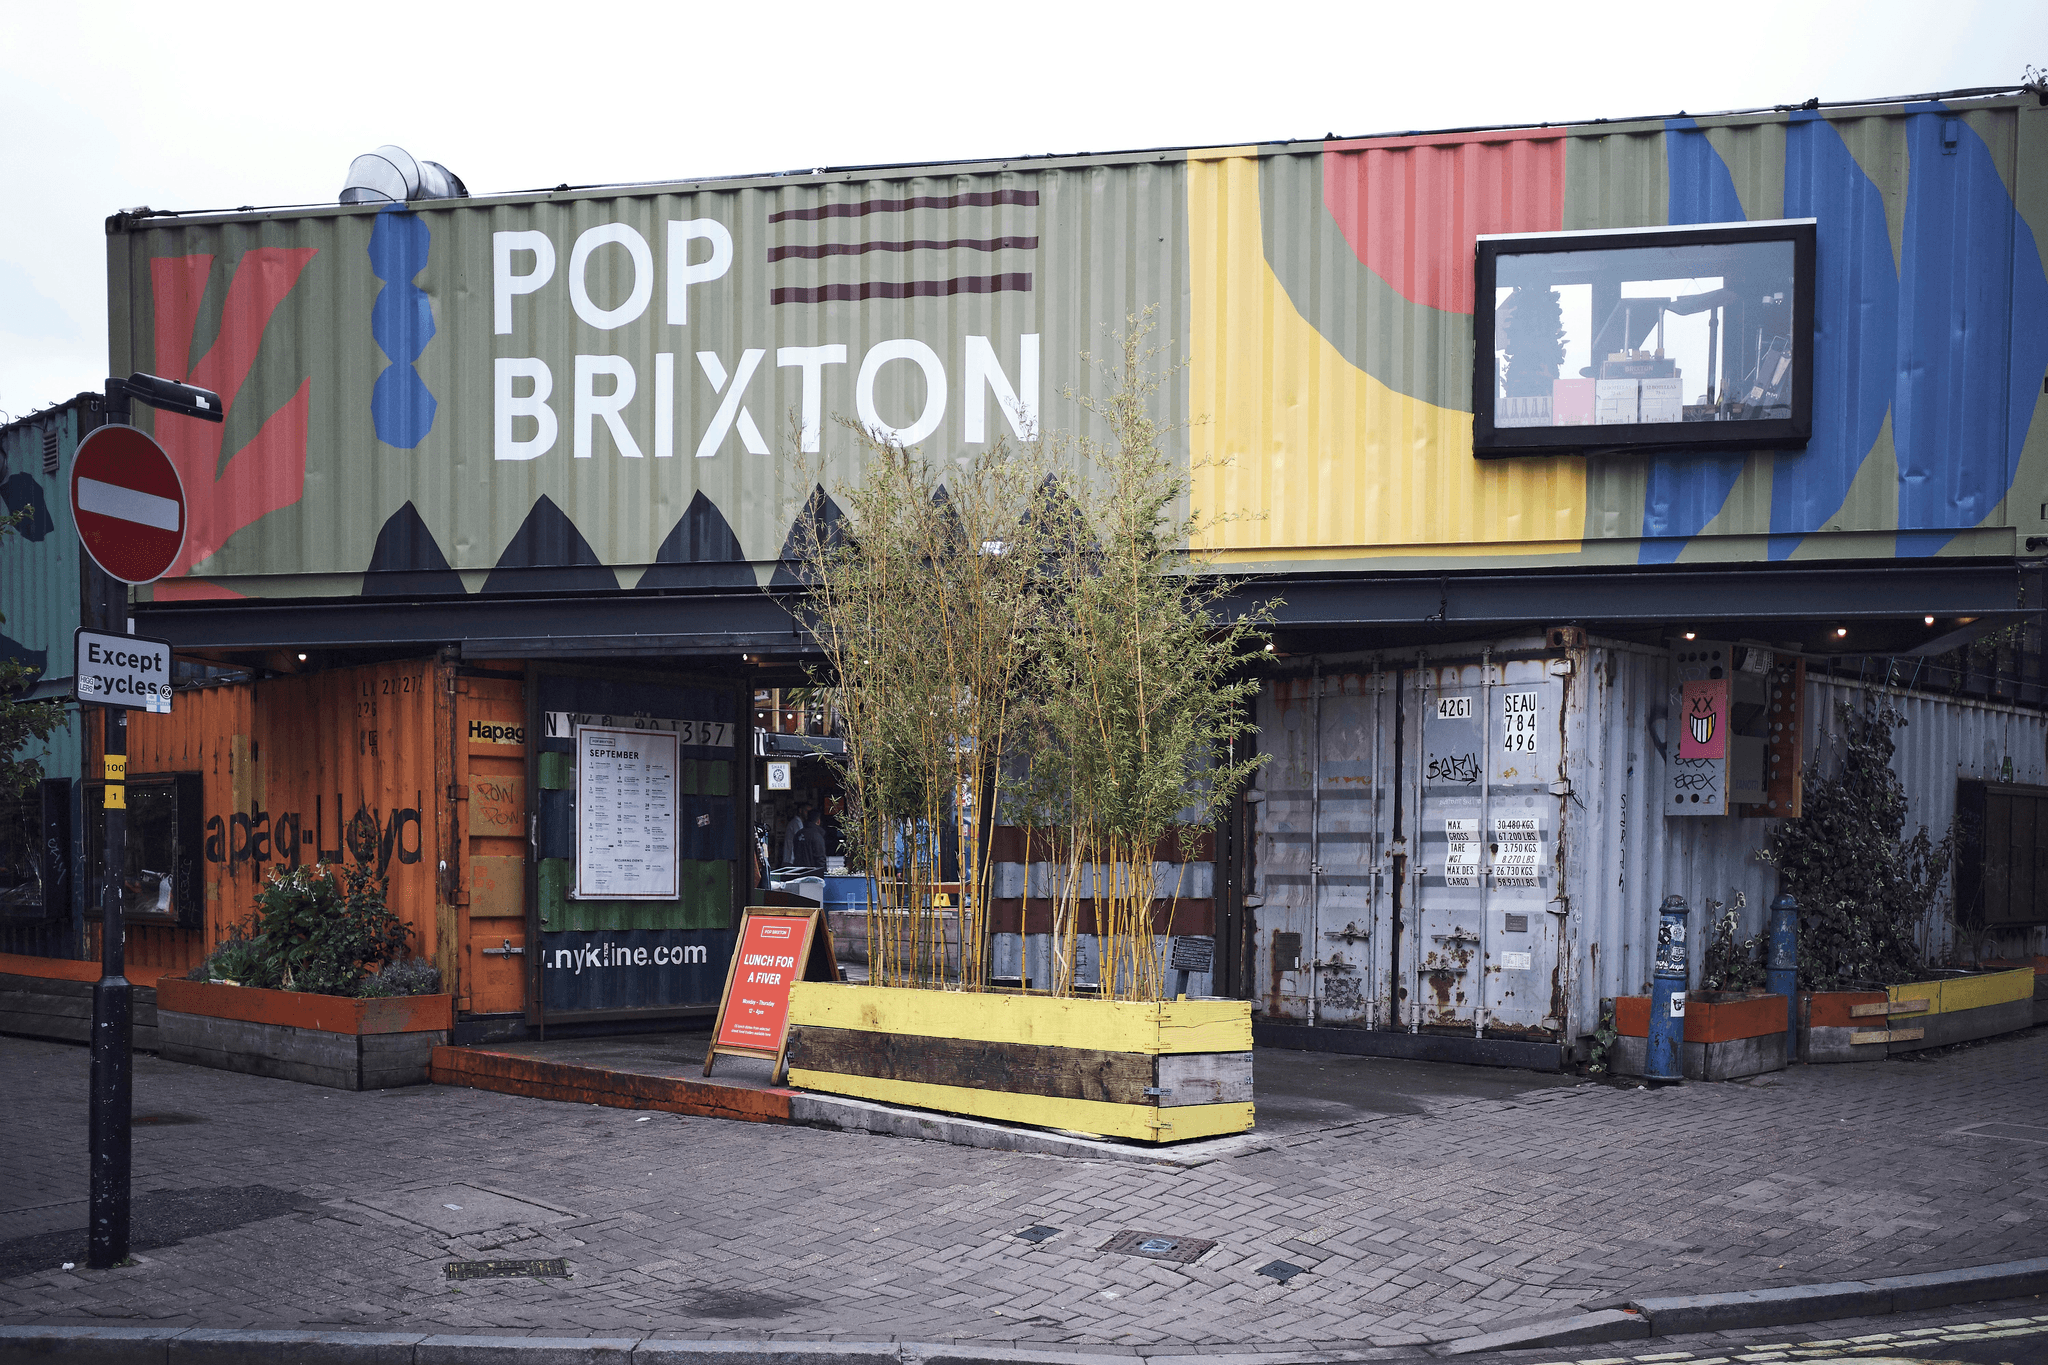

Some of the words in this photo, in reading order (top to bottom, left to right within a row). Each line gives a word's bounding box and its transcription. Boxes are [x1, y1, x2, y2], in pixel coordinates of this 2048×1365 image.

[493, 218, 734, 335] POP
[494, 333, 1040, 461] BRIXTON
[88, 642, 162, 674] Except
[92, 674, 158, 696] cycles
[1439, 698, 1471, 717] 42G1
[1505, 694, 1536, 713] SEAU
[1505, 714, 1536, 732] 784
[468, 720, 525, 744] Hapag
[1504, 734, 1535, 752] 496
[589, 748, 640, 760] SEPTEMBER
[106, 764, 124, 772] 100
[112, 792, 117, 800] 1
[1447, 820, 1462, 830] MAX.
[1449, 832, 1469, 841] GROSS
[1523, 832, 1538, 841] LBS.
[1450, 843, 1466, 853] TARE
[1504, 843, 1523, 853] 3.750
[1524, 843, 1538, 853] KGS.
[1496, 866, 1519, 875] 26.730
[1447, 877, 1470, 886] CARGO
[543, 942, 707, 975] .nykline.com
[743, 953, 775, 967] LUNCH
[775, 955, 794, 968] FOR
[747, 971, 754, 983] A
[755, 972, 781, 985] FIVER
[742, 998, 756, 1006] Monday
[759, 999, 775, 1008] Thursday
